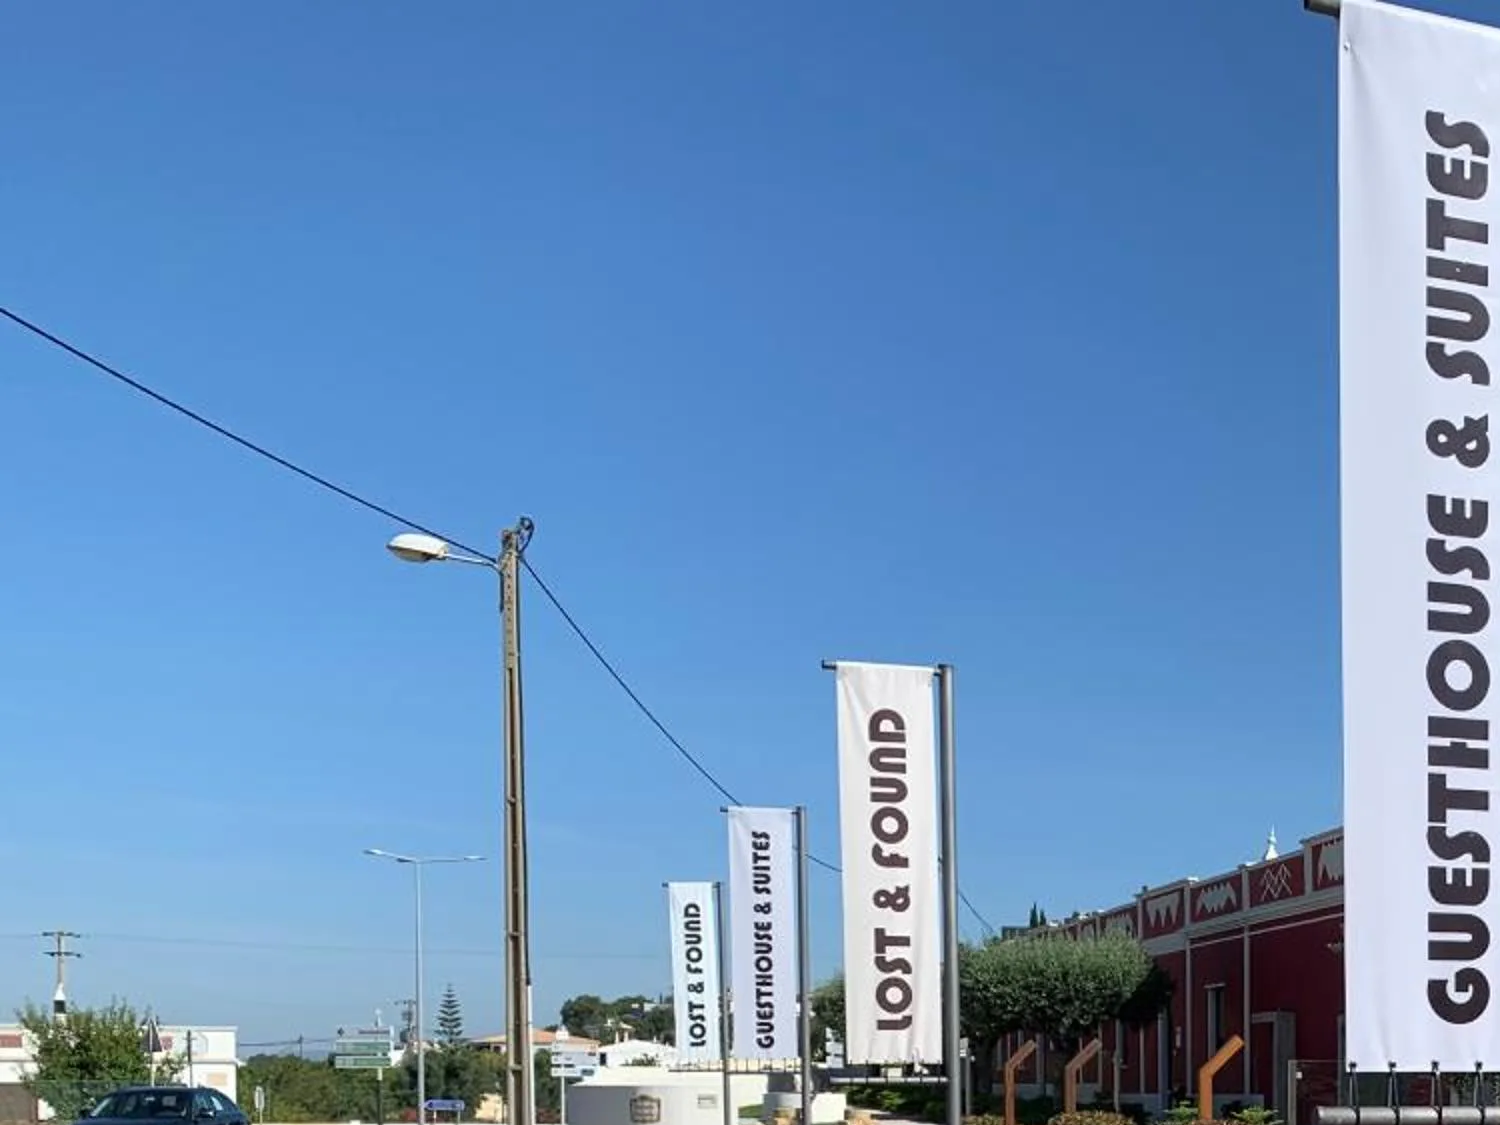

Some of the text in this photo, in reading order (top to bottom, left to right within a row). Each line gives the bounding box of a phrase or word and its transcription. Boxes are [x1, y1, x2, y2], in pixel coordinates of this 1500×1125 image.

[1425, 110, 1491, 1025] GUESTHOUSE & SUITES
[683, 903, 707, 1048] LOST & FOUND
[751, 830, 775, 1050] GUESTHOUSE & SUITES
[868, 708, 913, 1031] LOST & FOUND
